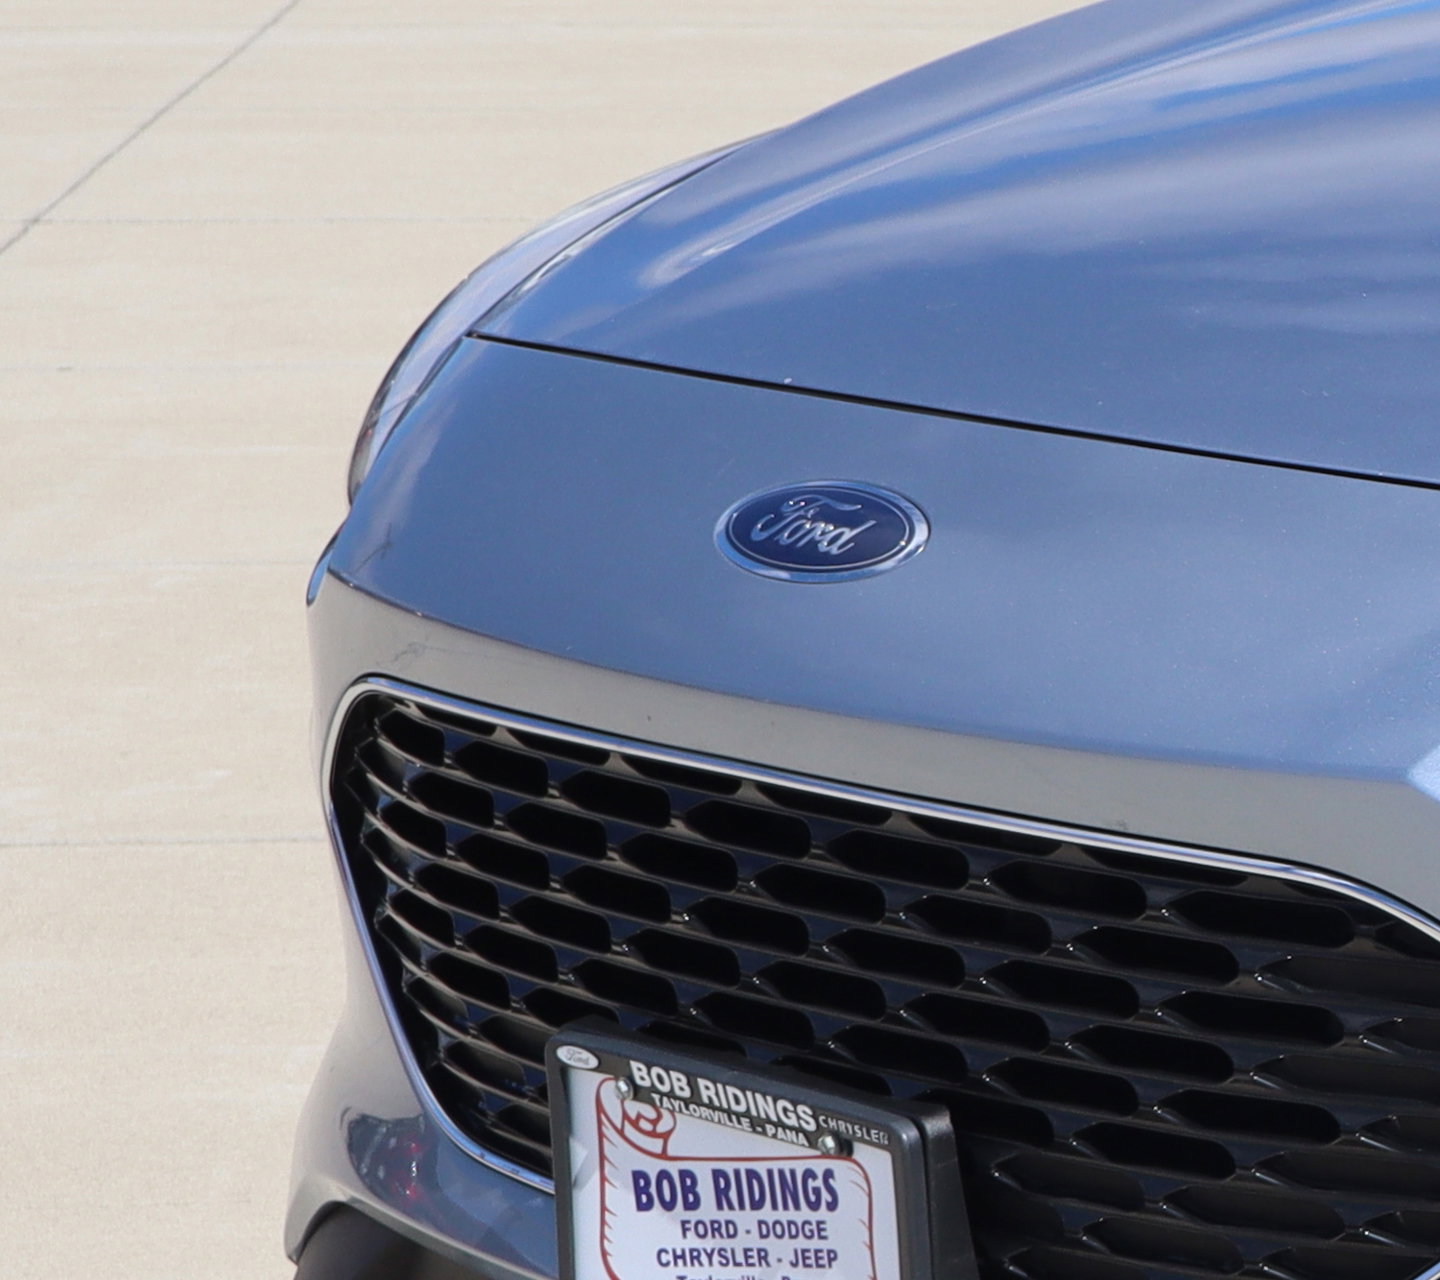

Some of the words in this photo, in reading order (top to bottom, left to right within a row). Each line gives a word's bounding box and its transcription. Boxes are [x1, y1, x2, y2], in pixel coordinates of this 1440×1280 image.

[751, 493, 877, 556] Ford
[629, 1060, 692, 1098] BOB
[697, 1077, 818, 1132] RIDINGS
[818, 1115, 889, 1145] CHRYSLER
[651, 1092, 753, 1132] TAYLORVILLE
[765, 1123, 810, 1147] PANA
[631, 1169, 701, 1212] BOB
[711, 1168, 840, 1212] RIDINGS
[680, 1220, 739, 1240] FORD
[758, 1220, 829, 1240] DODGE
[656, 1247, 771, 1269] CHRYSLER
[789, 1248, 839, 1269] JEEP
